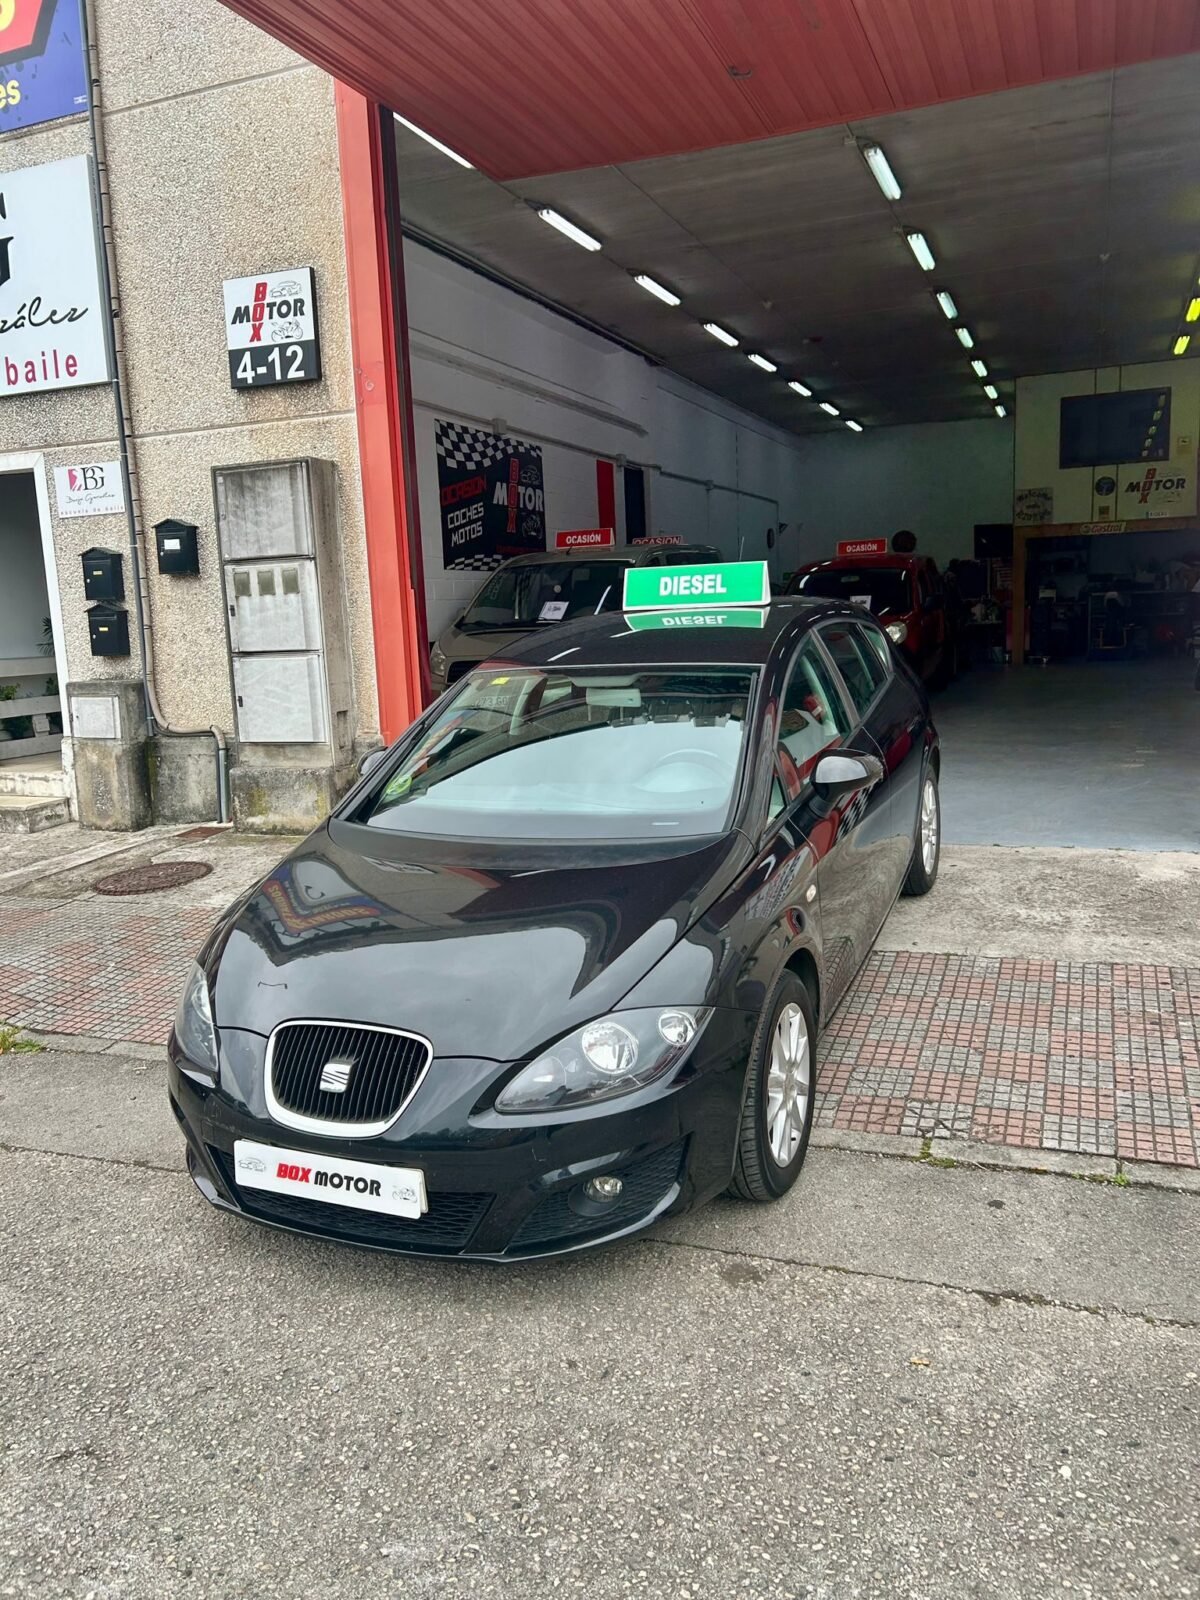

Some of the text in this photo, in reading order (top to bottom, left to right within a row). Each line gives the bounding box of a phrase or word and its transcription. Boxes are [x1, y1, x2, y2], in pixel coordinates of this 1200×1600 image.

[231, 298, 305, 325] MOTOR
[249, 282, 268, 343] BOX
[4, 349, 78, 386] baile
[236, 344, 305, 384] 4-12
[492, 481, 544, 512] MOTOR
[1124, 478, 1186, 493] MOTOR
[447, 501, 485, 529] COCHES
[451, 521, 483, 547] MOTOS
[566, 532, 602, 544] OCASIÓN
[659, 573, 727, 597] DIESEL
[276, 1163, 382, 1197] BOX MOTOR
